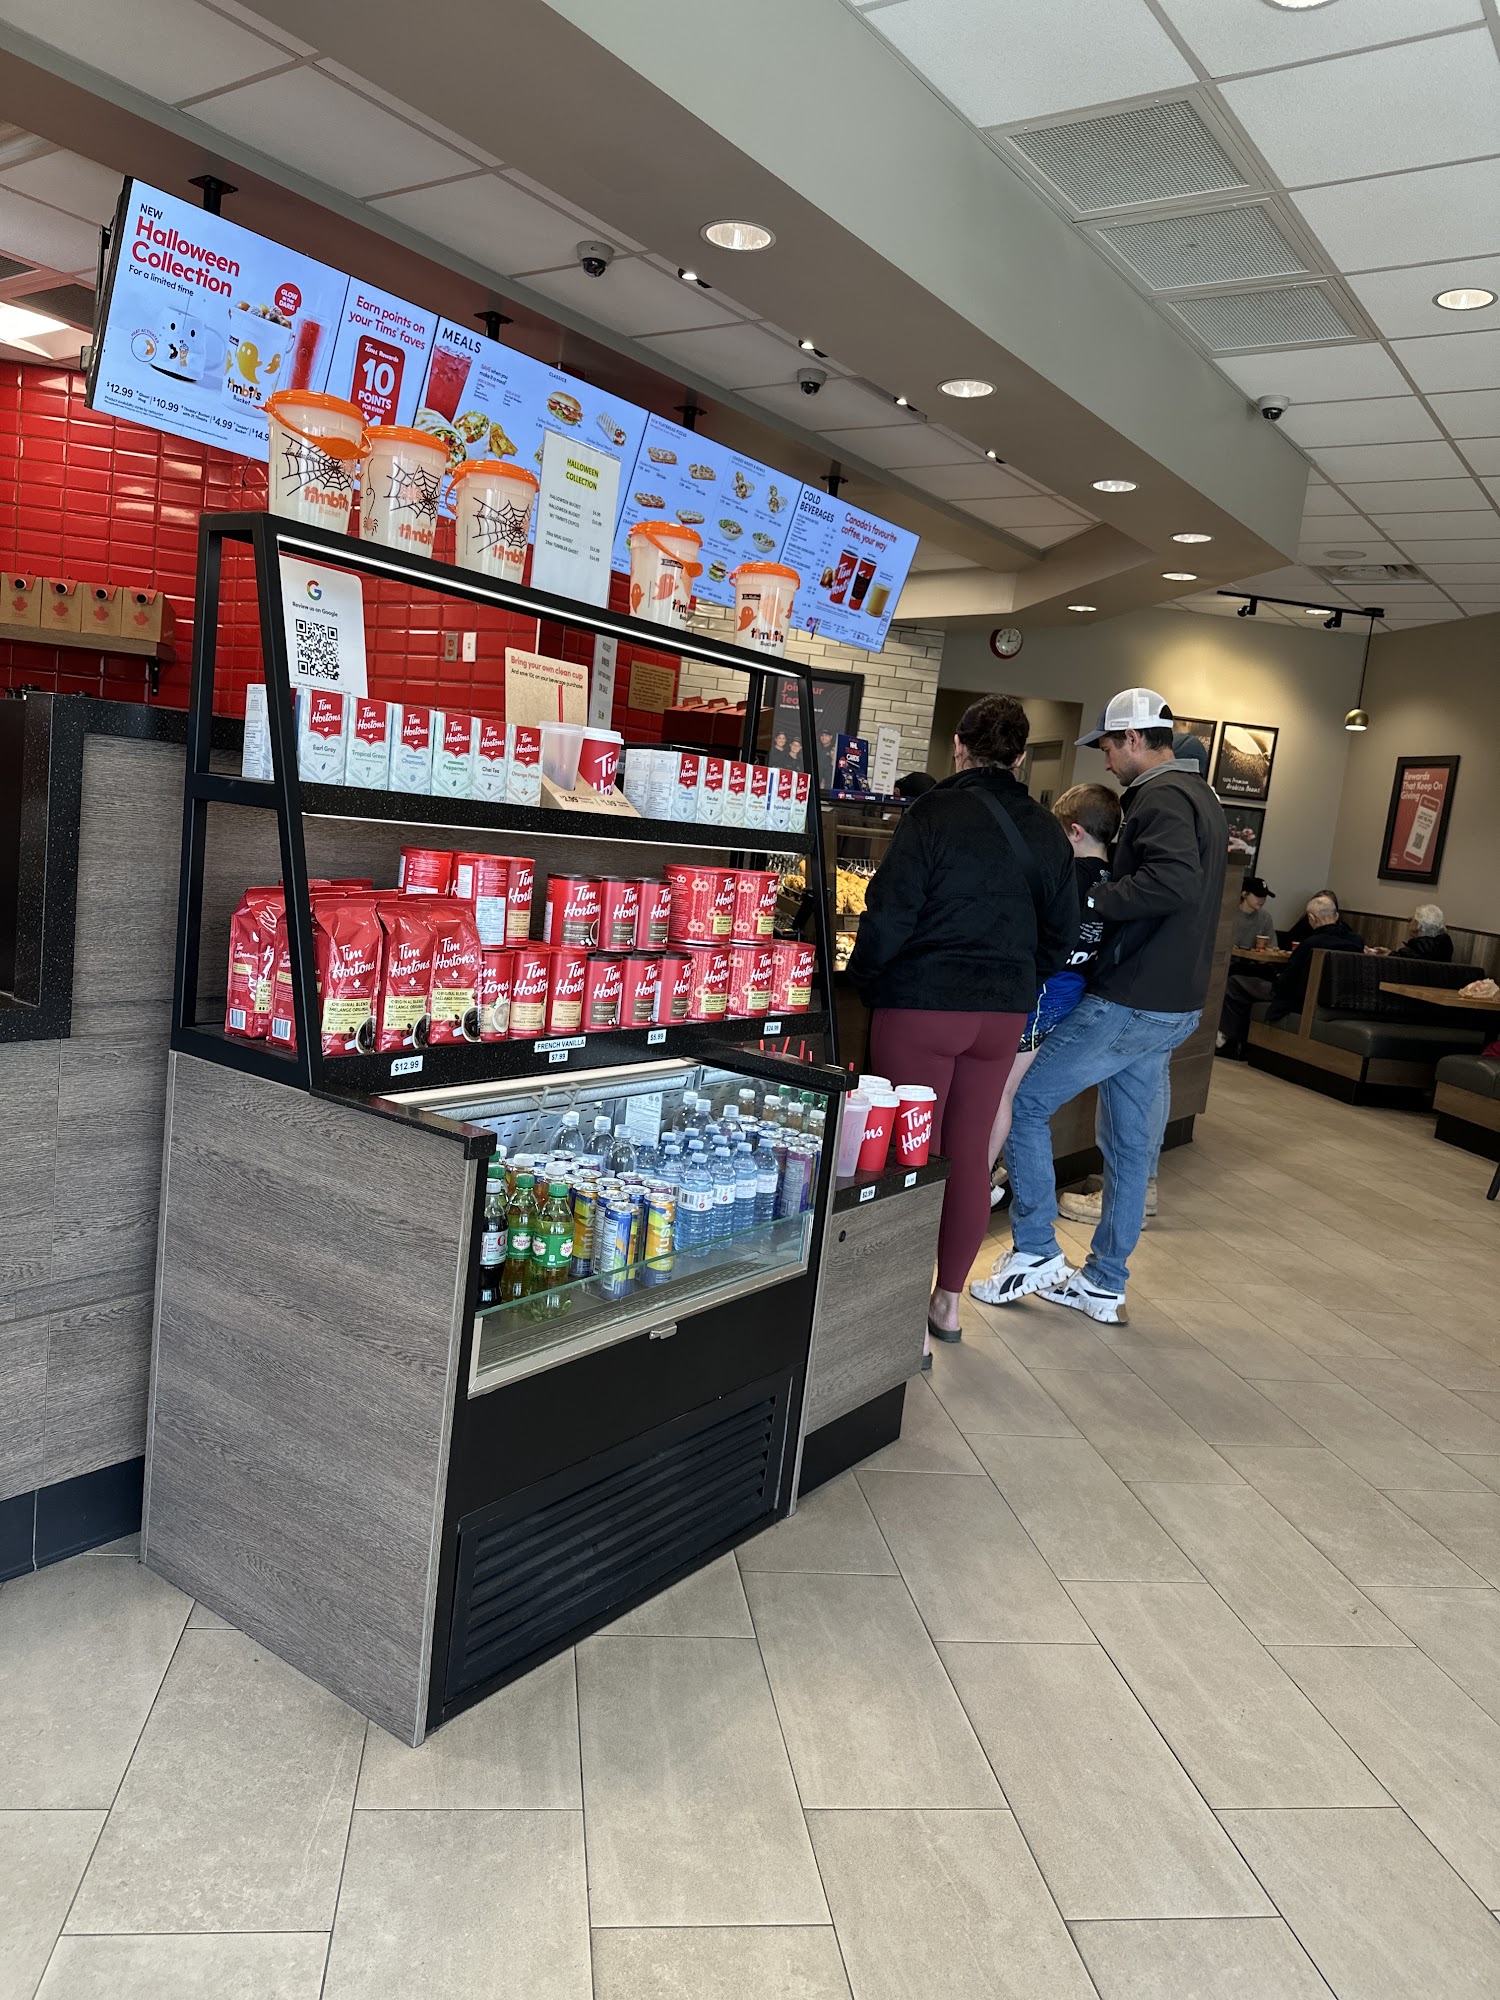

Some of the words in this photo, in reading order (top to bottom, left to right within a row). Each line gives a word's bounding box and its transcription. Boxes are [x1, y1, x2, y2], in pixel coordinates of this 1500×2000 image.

[140, 203, 163, 220] NEW
[136, 216, 240, 277] Halloween
[132, 241, 232, 298] Collection
[129, 264, 142, 276] For
[150, 273, 176, 290] limited
[178, 284, 194, 296] time
[281, 288, 298, 302] GLOW
[278, 300, 296, 312] DARK!
[356, 296, 380, 316] Earn
[382, 308, 411, 328] points
[413, 323, 425, 334] on
[348, 311, 372, 328] your
[400, 330, 426, 350] faves
[442, 328, 482, 354] MEALS
[364, 342, 378, 356] Tims
[362, 358, 395, 396] 10
[228, 377, 262, 401] timbits
[106, 382, 134, 398] $12.99
[153, 397, 179, 412] $10.99
[212, 416, 232, 430] $4.99
[358, 390, 392, 410] POINTS
[566, 458, 599, 478] HALLOWEEN
[566, 472, 597, 490] COLLECTION
[550, 494, 568, 505] HALLOWEEN
[804, 490, 820, 504] COLD
[548, 502, 568, 514] HALLOWEEN
[800, 501, 834, 522] BEVERAGES
[845, 512, 872, 532] Canada's
[872, 524, 897, 543] favourite
[562, 536, 574, 544] GHOST
[841, 526, 862, 540] coffee,
[860, 534, 874, 546] your
[875, 541, 888, 552] way
[568, 547, 578, 555] GHOST
[292, 601, 309, 610] Review
[322, 608, 338, 618] Google
[751, 628, 784, 643] timbits
[511, 655, 528, 668] Bring
[528, 662, 541, 670] your
[542, 666, 554, 674] own
[555, 668, 572, 678] clean
[572, 673, 584, 681] cup
[548, 676, 566, 686] beverage
[812, 688, 824, 696] ur
[316, 698, 332, 711] Tim
[782, 694, 800, 704] Tea
[312, 711, 342, 724] Hortons
[362, 706, 376, 718] Tim
[358, 718, 385, 730] Hortons
[407, 714, 420, 725] Tim
[403, 726, 428, 736] Hortons
[450, 721, 462, 732] Tim
[485, 726, 498, 736] Tim
[446, 732, 470, 744] Hortons
[481, 738, 505, 748] Hortons
[520, 733, 532, 744] Tim
[352, 750, 372, 760] Tropical
[516, 744, 540, 754] Hortons
[684, 760, 694, 769] Tim
[846, 754, 860, 762] CARDS
[442, 764, 468, 774] Peppermint
[680, 769, 698, 778] Hortons
[709, 762, 718, 772] Tim
[1404, 772, 1430, 780] Rewards
[1226, 782, 1245, 792] Arabica
[1402, 782, 1416, 790] That
[1416, 782, 1432, 792] Keep
[1433, 781, 1443, 790] On
[1400, 790, 1420, 802] Giving
[574, 884, 596, 902] Tim
[399, 943, 420, 960] Tim
[441, 937, 460, 954] Tim
[340, 944, 363, 961] Tim
[799, 952, 812, 966] Tim
[435, 953, 475, 970] Hortons
[712, 954, 728, 970] Tim
[332, 961, 375, 978] Hortons
[391, 960, 430, 978] Hortons
[524, 960, 546, 980] Tim
[650, 1033, 664, 1041] $5.99
[536, 1042, 560, 1050] FRENCH
[561, 1038, 586, 1048] VANILLA
[552, 1052, 566, 1060] $7.99
[394, 1060, 419, 1072] $12.99
[901, 1106, 932, 1130] Tim
[862, 1190, 874, 1198] $2.99
